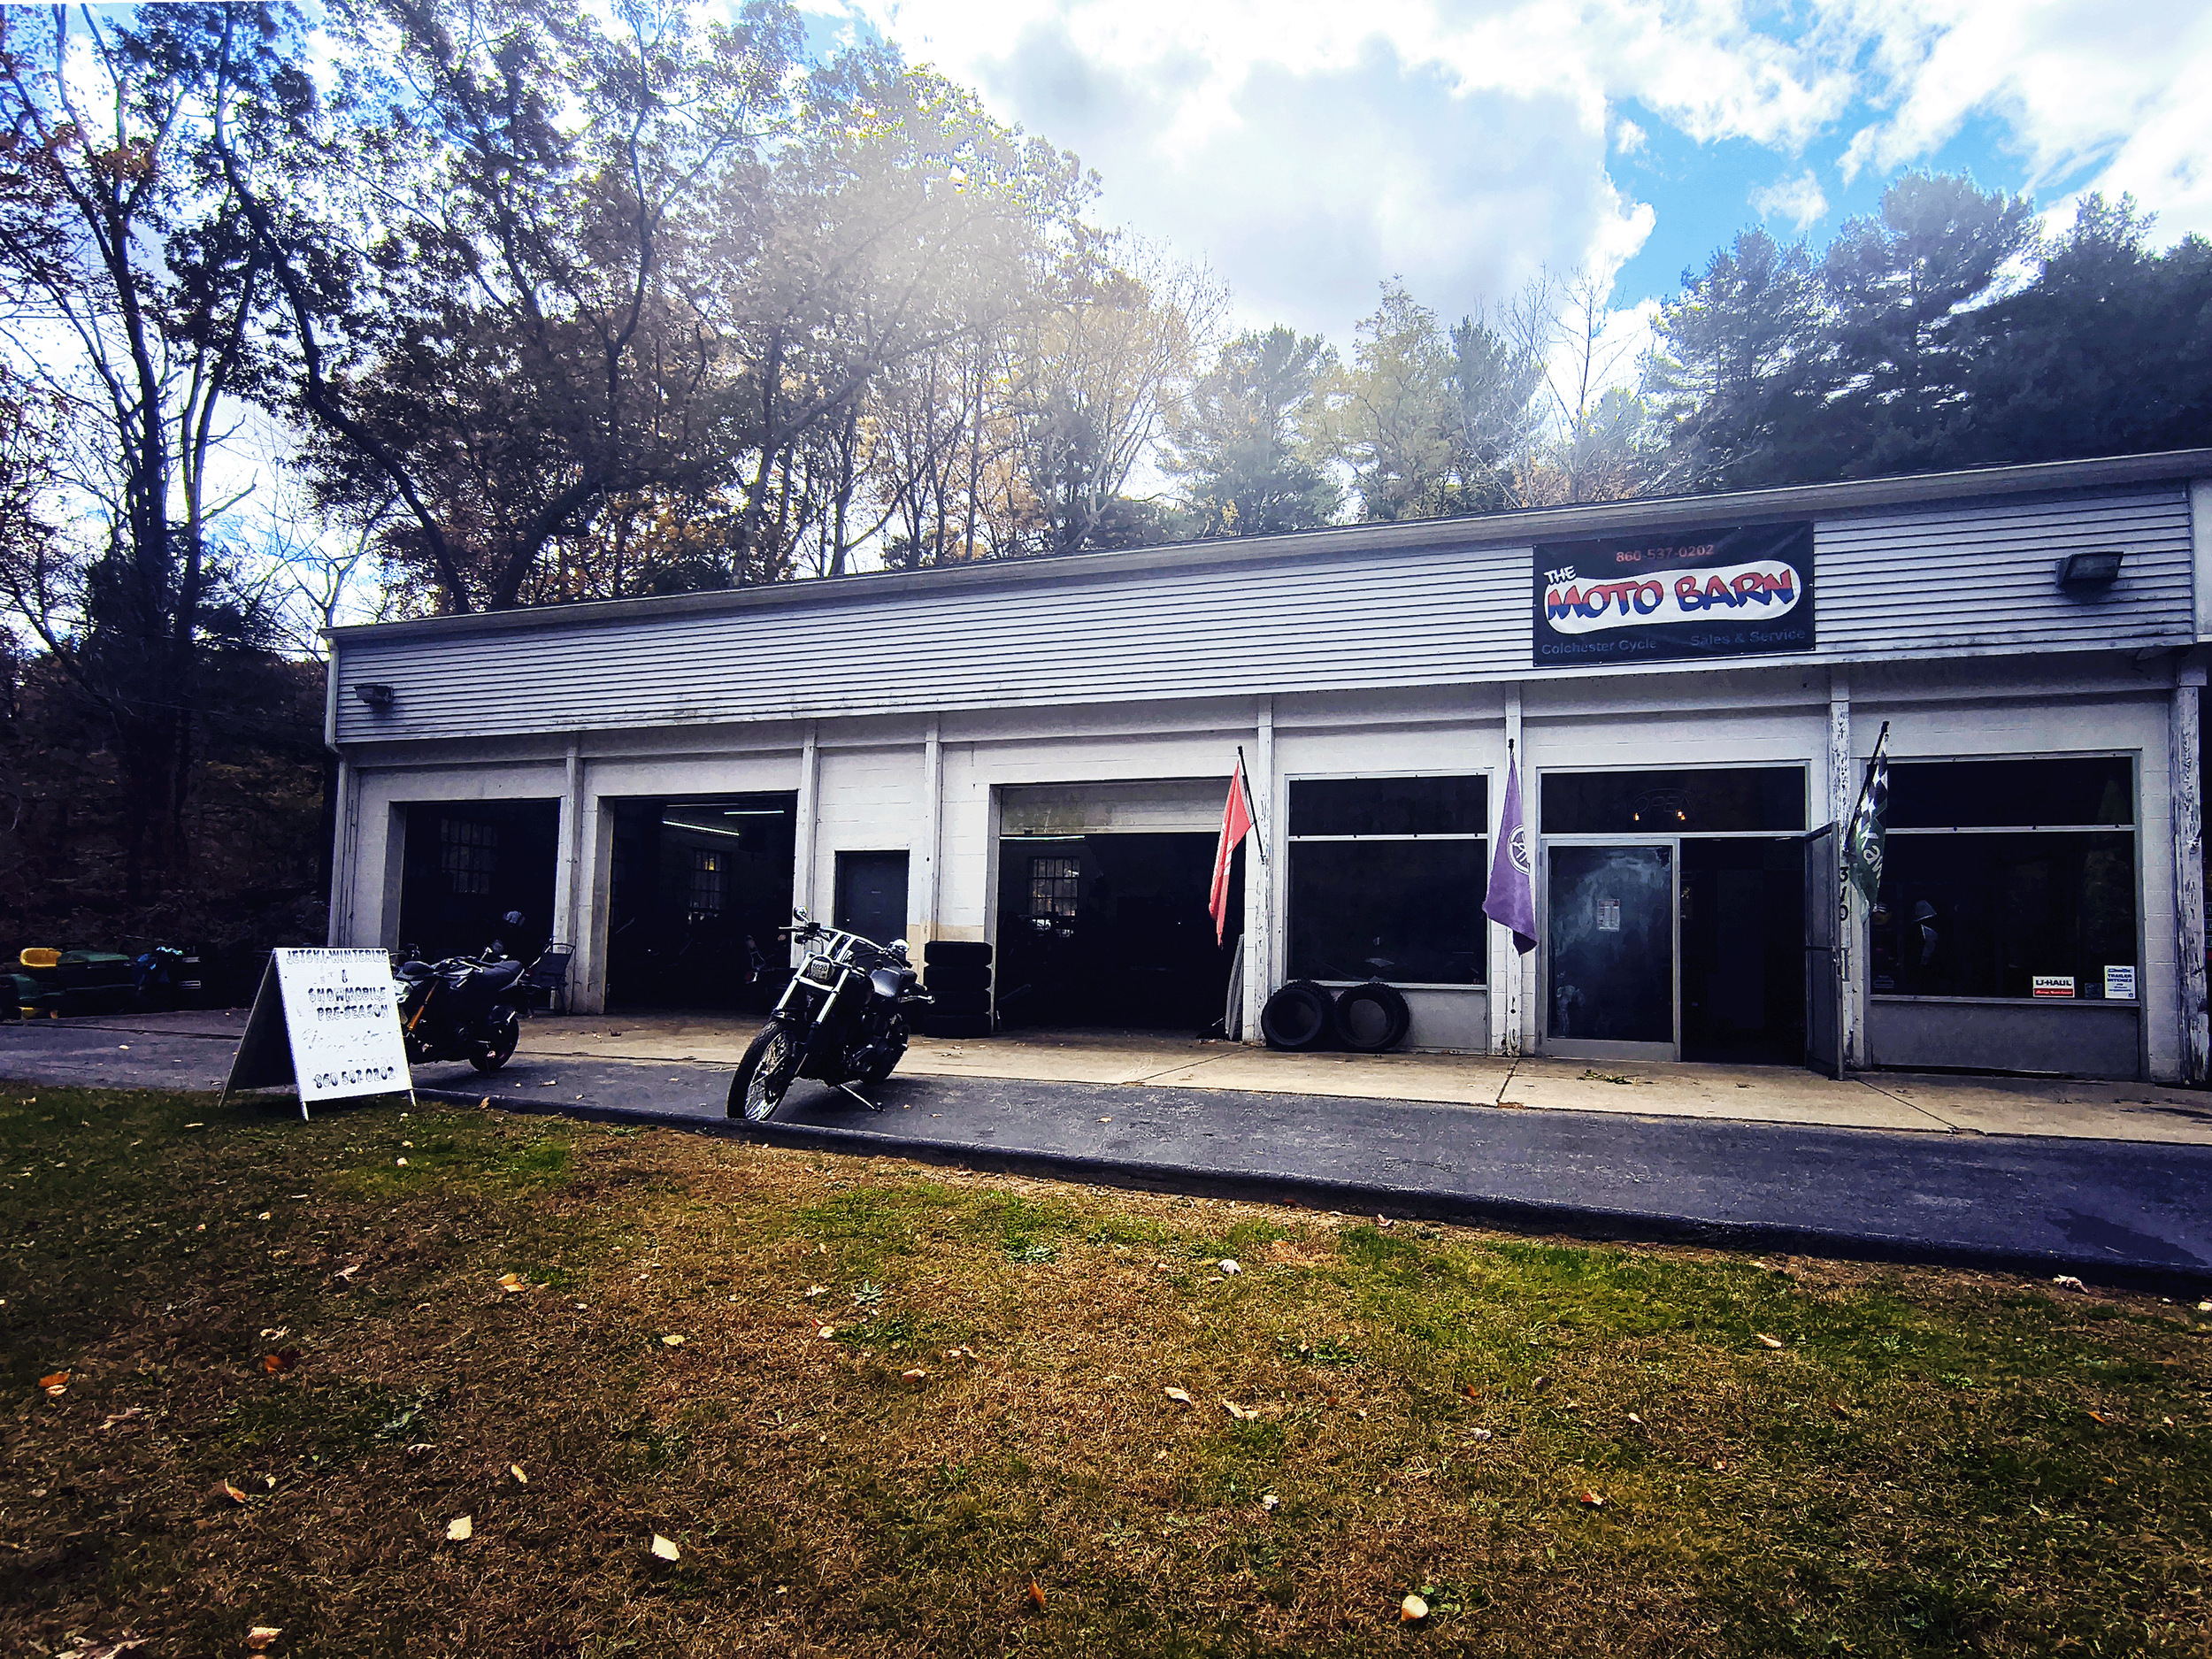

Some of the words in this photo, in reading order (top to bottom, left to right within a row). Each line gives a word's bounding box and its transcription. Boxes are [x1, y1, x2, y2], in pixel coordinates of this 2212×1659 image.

[1615, 544, 1715, 563] 860-537-0202
[1543, 565, 1577, 586] THE
[1548, 579, 1663, 621] MOTO
[1674, 569, 1794, 611] BARN
[1540, 640, 1616, 656] Colchester
[1618, 639, 1657, 655] Cycle
[1690, 633, 1731, 648] Sales
[1733, 631, 1746, 644] &
[1749, 627, 1806, 643] Service
